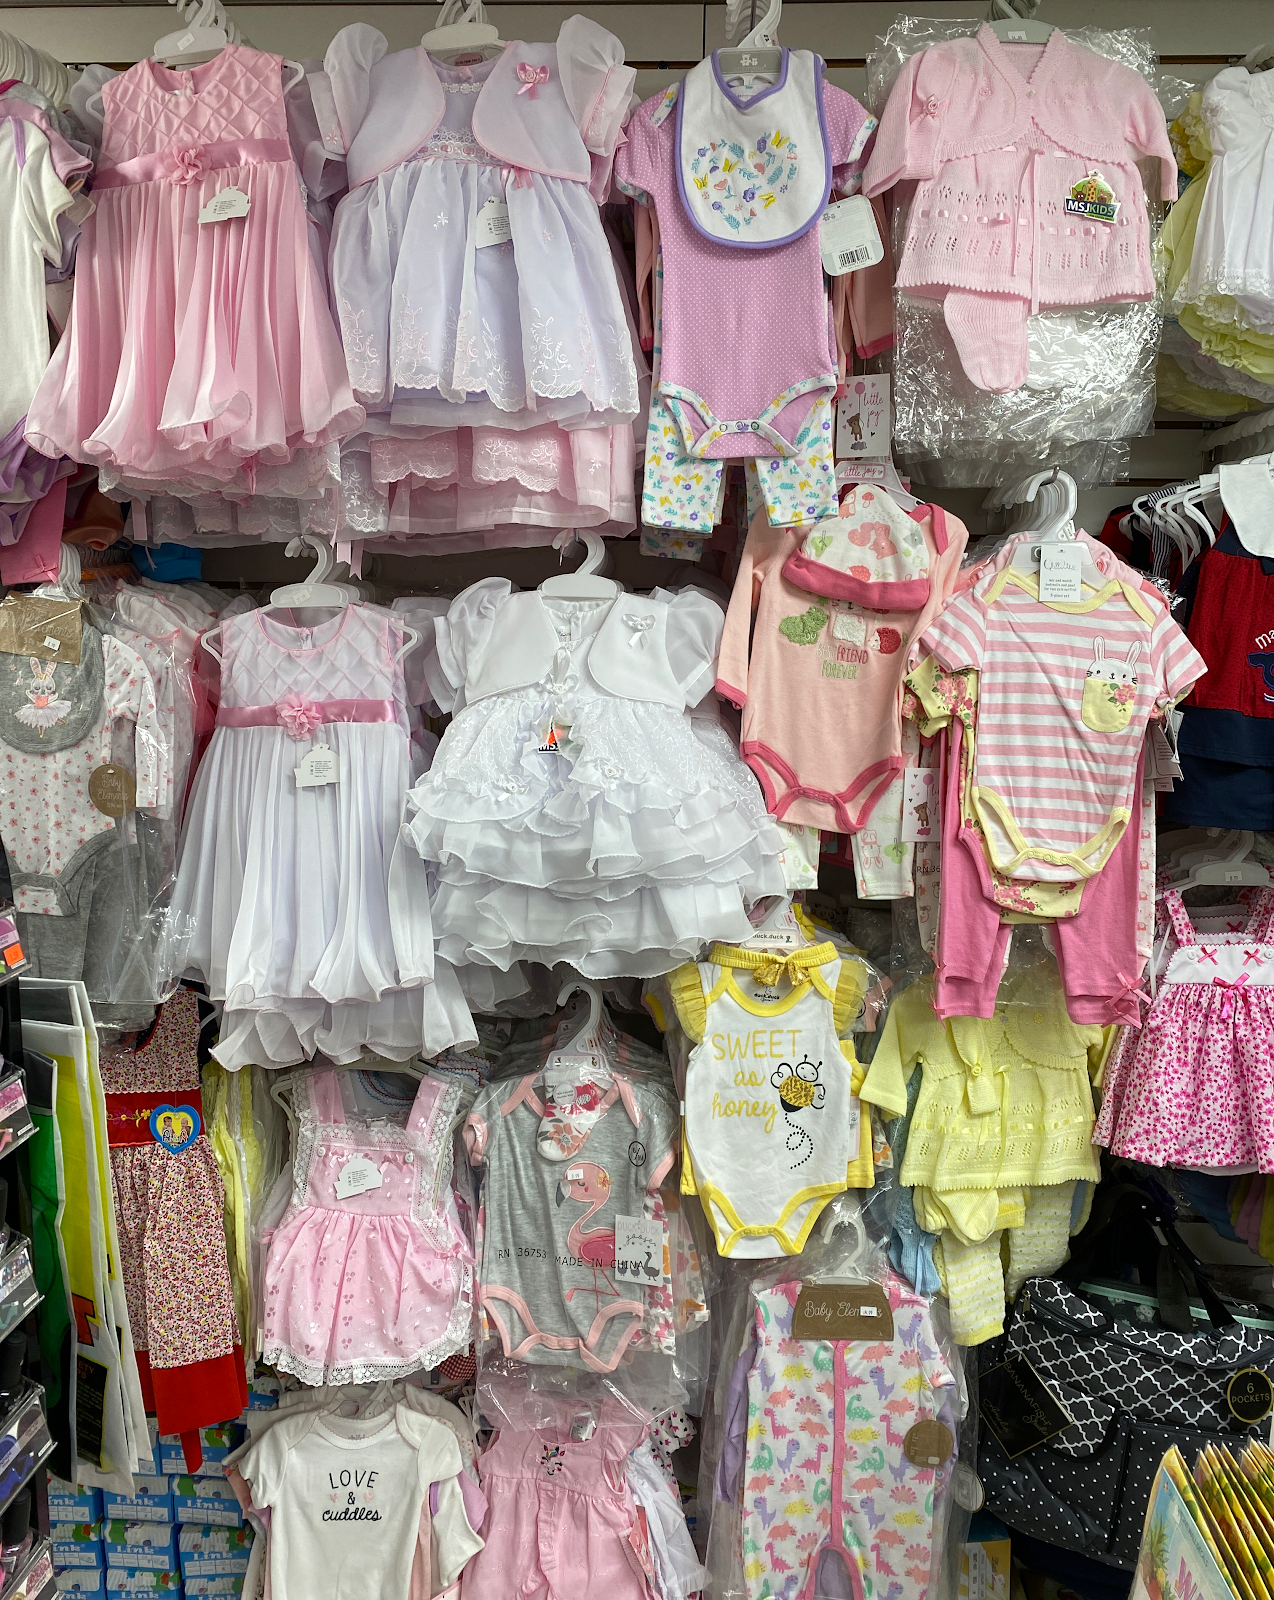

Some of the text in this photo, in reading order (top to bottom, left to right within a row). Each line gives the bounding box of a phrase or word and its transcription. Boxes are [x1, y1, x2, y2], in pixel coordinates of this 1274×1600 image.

[1067, 199, 1113, 216] MSJKIDS
[863, 392, 884, 406] little
[866, 407, 884, 428] joy
[844, 465, 876, 478] little joy
[817, 644, 869, 664] BEST FRIEND
[822, 660, 857, 679] FOREVER
[711, 1029, 802, 1061] SWEET
[734, 1070, 766, 1087] as
[712, 1091, 778, 1134] honey
[617, 1221, 660, 1235] DUCK DUCK
[498, 1248, 547, 1259] RN 36753
[555, 1256, 645, 1270] MADE IN CHINA
[804, 1300, 883, 1322] Baby Elems
[1246, 1383, 1254, 1393] 6
[1232, 1393, 1270, 1403] POCKETS
[329, 1469, 379, 1489] LOVE
[48, 1496, 74, 1505] ink
[116, 1496, 153, 1506] Link
[187, 1499, 224, 1511] Link
[347, 1491, 356, 1505] &
[322, 1507, 382, 1521] cuddles
[53, 1543, 80, 1552] ink
[117, 1545, 154, 1555] Link
[193, 1551, 232, 1561] Link
[121, 1591, 160, 1600] Link
